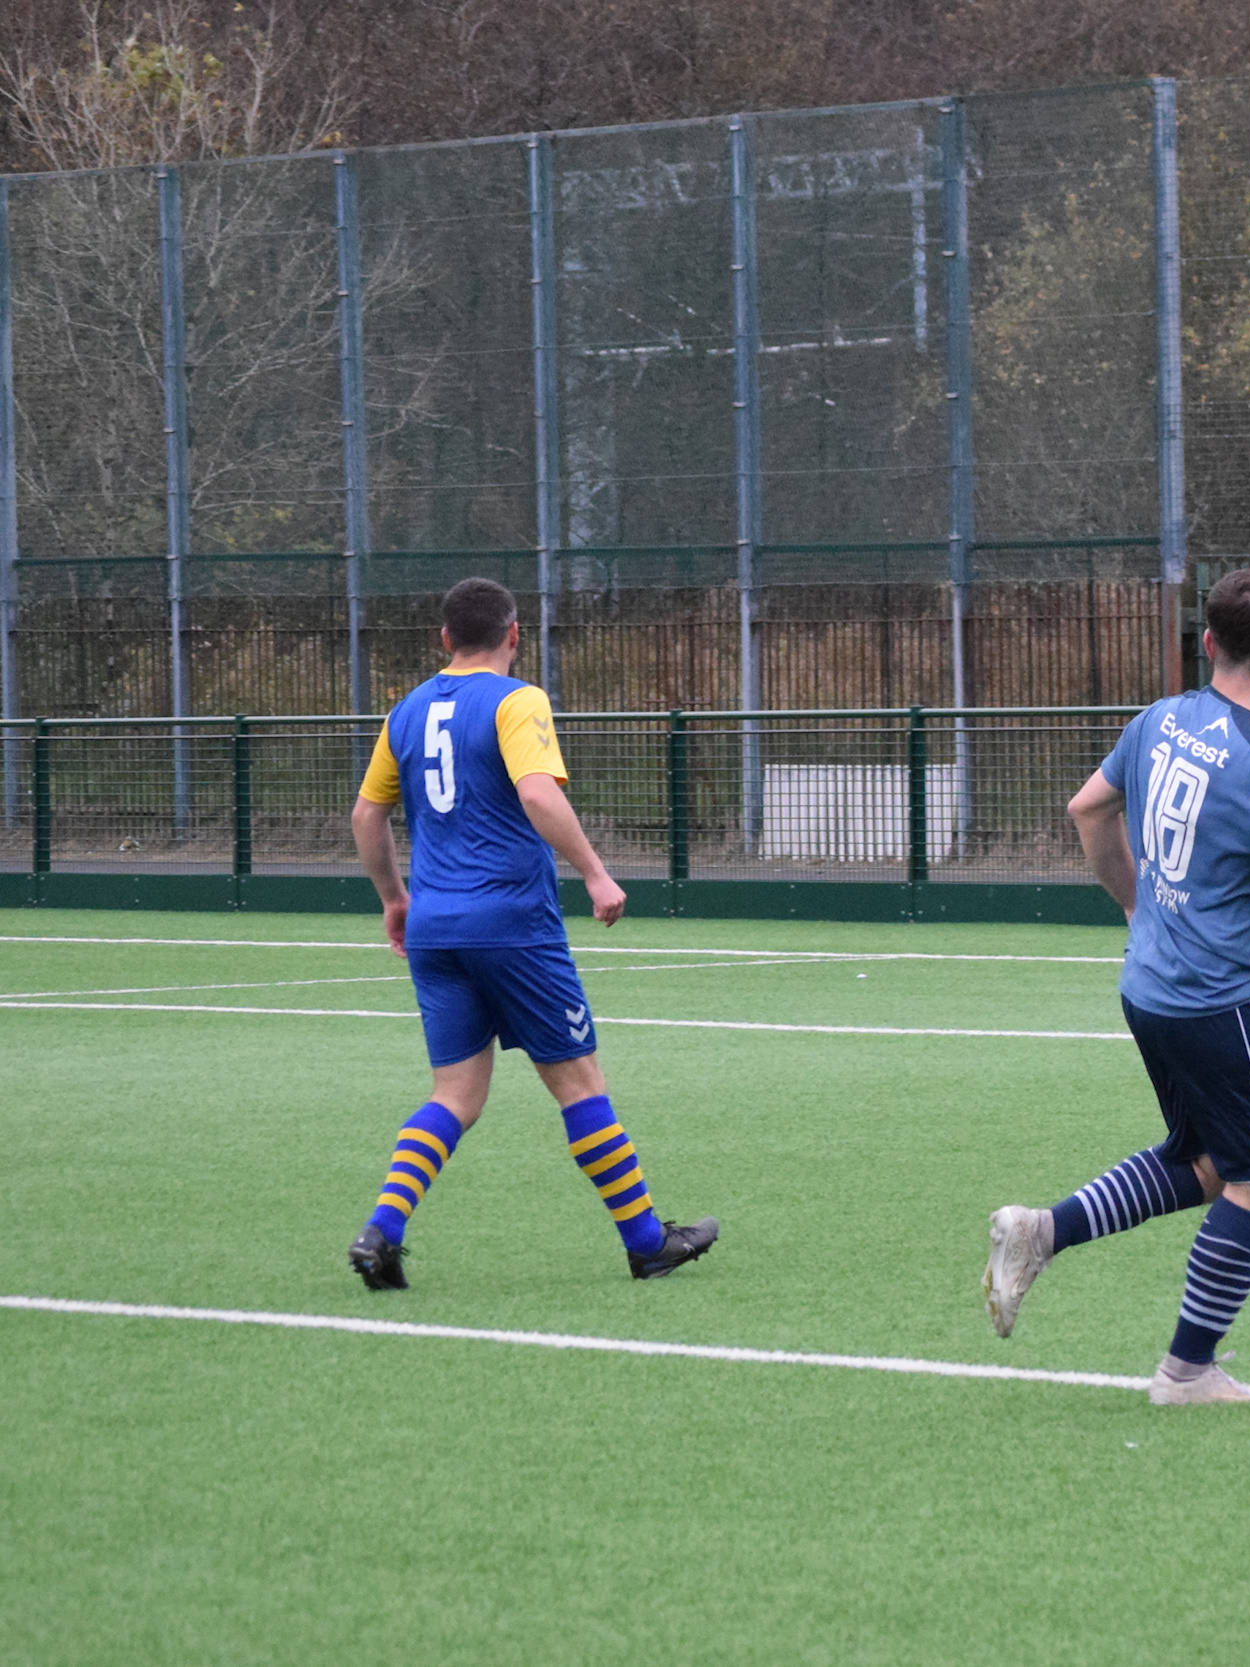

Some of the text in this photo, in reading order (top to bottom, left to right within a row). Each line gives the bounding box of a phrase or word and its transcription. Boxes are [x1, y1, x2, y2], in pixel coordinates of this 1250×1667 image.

[424, 701, 456, 814] 5
[1160, 713, 1230, 769] Everest
[1143, 742, 1209, 882] 18
